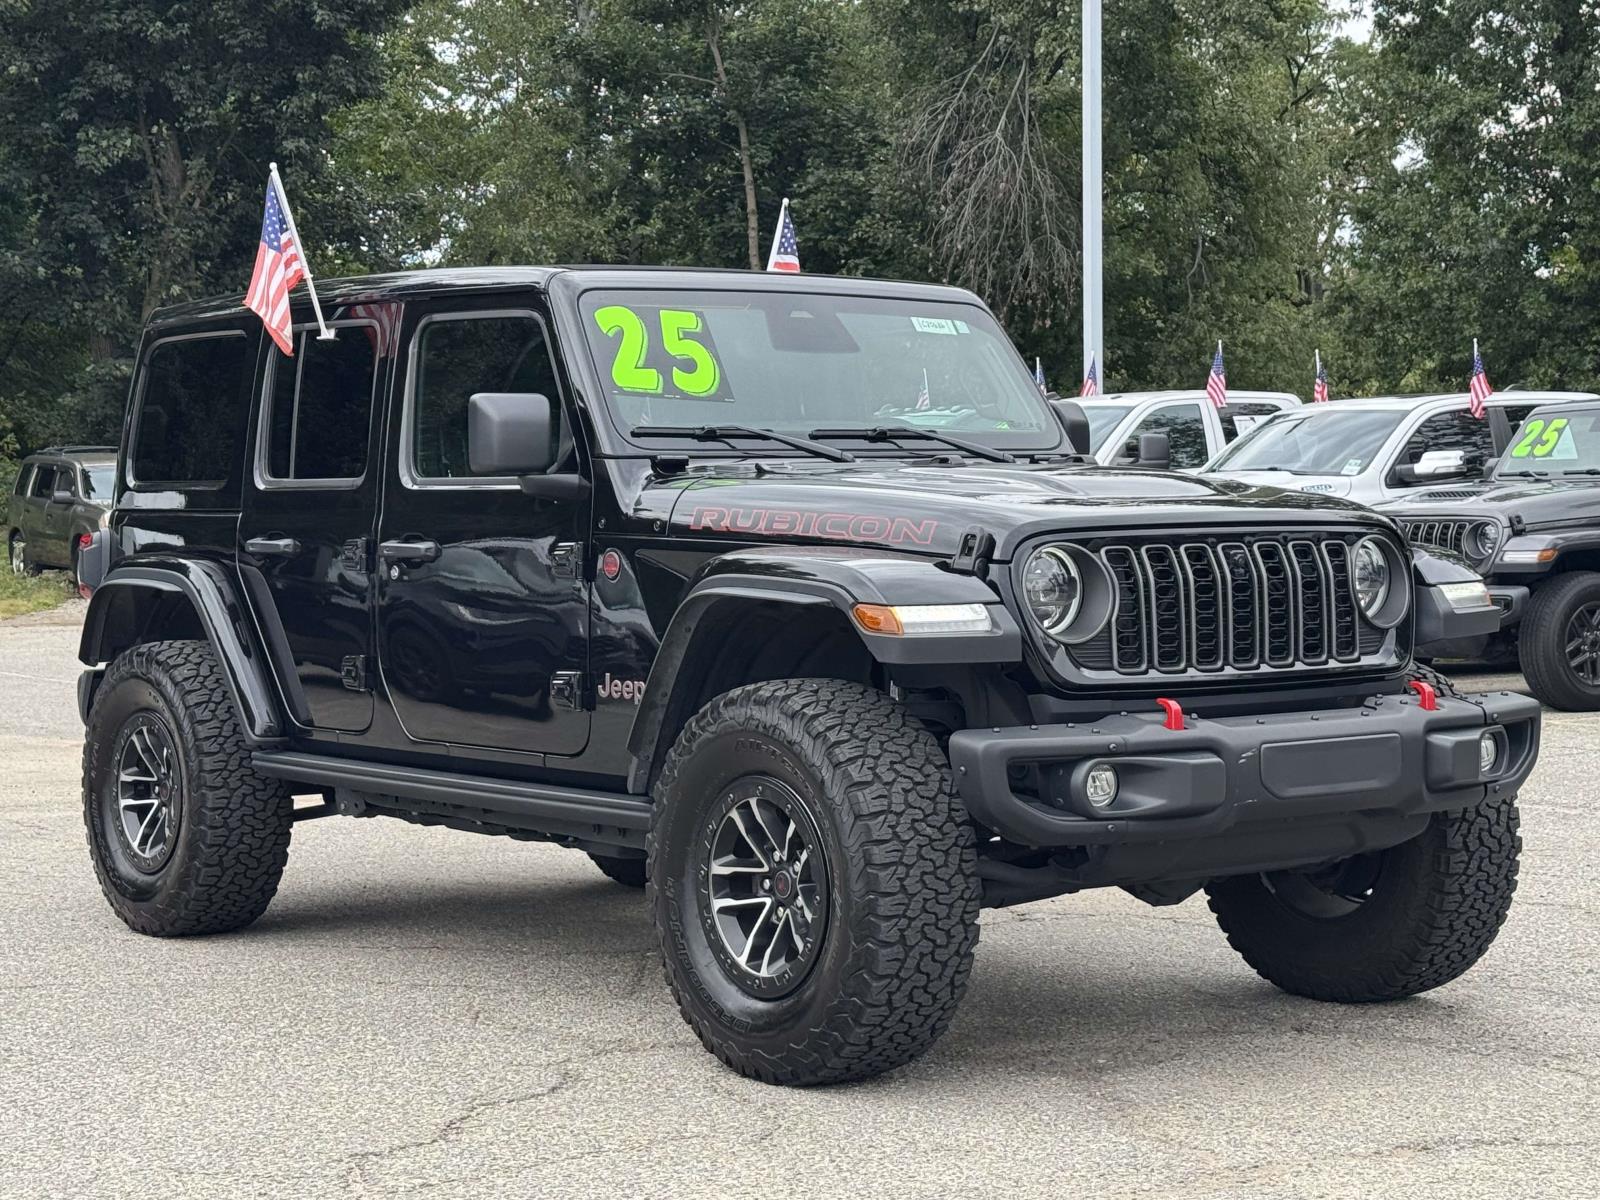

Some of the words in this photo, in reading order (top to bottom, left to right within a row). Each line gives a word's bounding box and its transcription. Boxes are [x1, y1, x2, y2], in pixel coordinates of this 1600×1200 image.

[594, 305, 720, 397] 25
[1511, 418, 1569, 457] 25
[690, 506, 938, 545] RUBICON
[597, 672, 646, 705] Jeep
